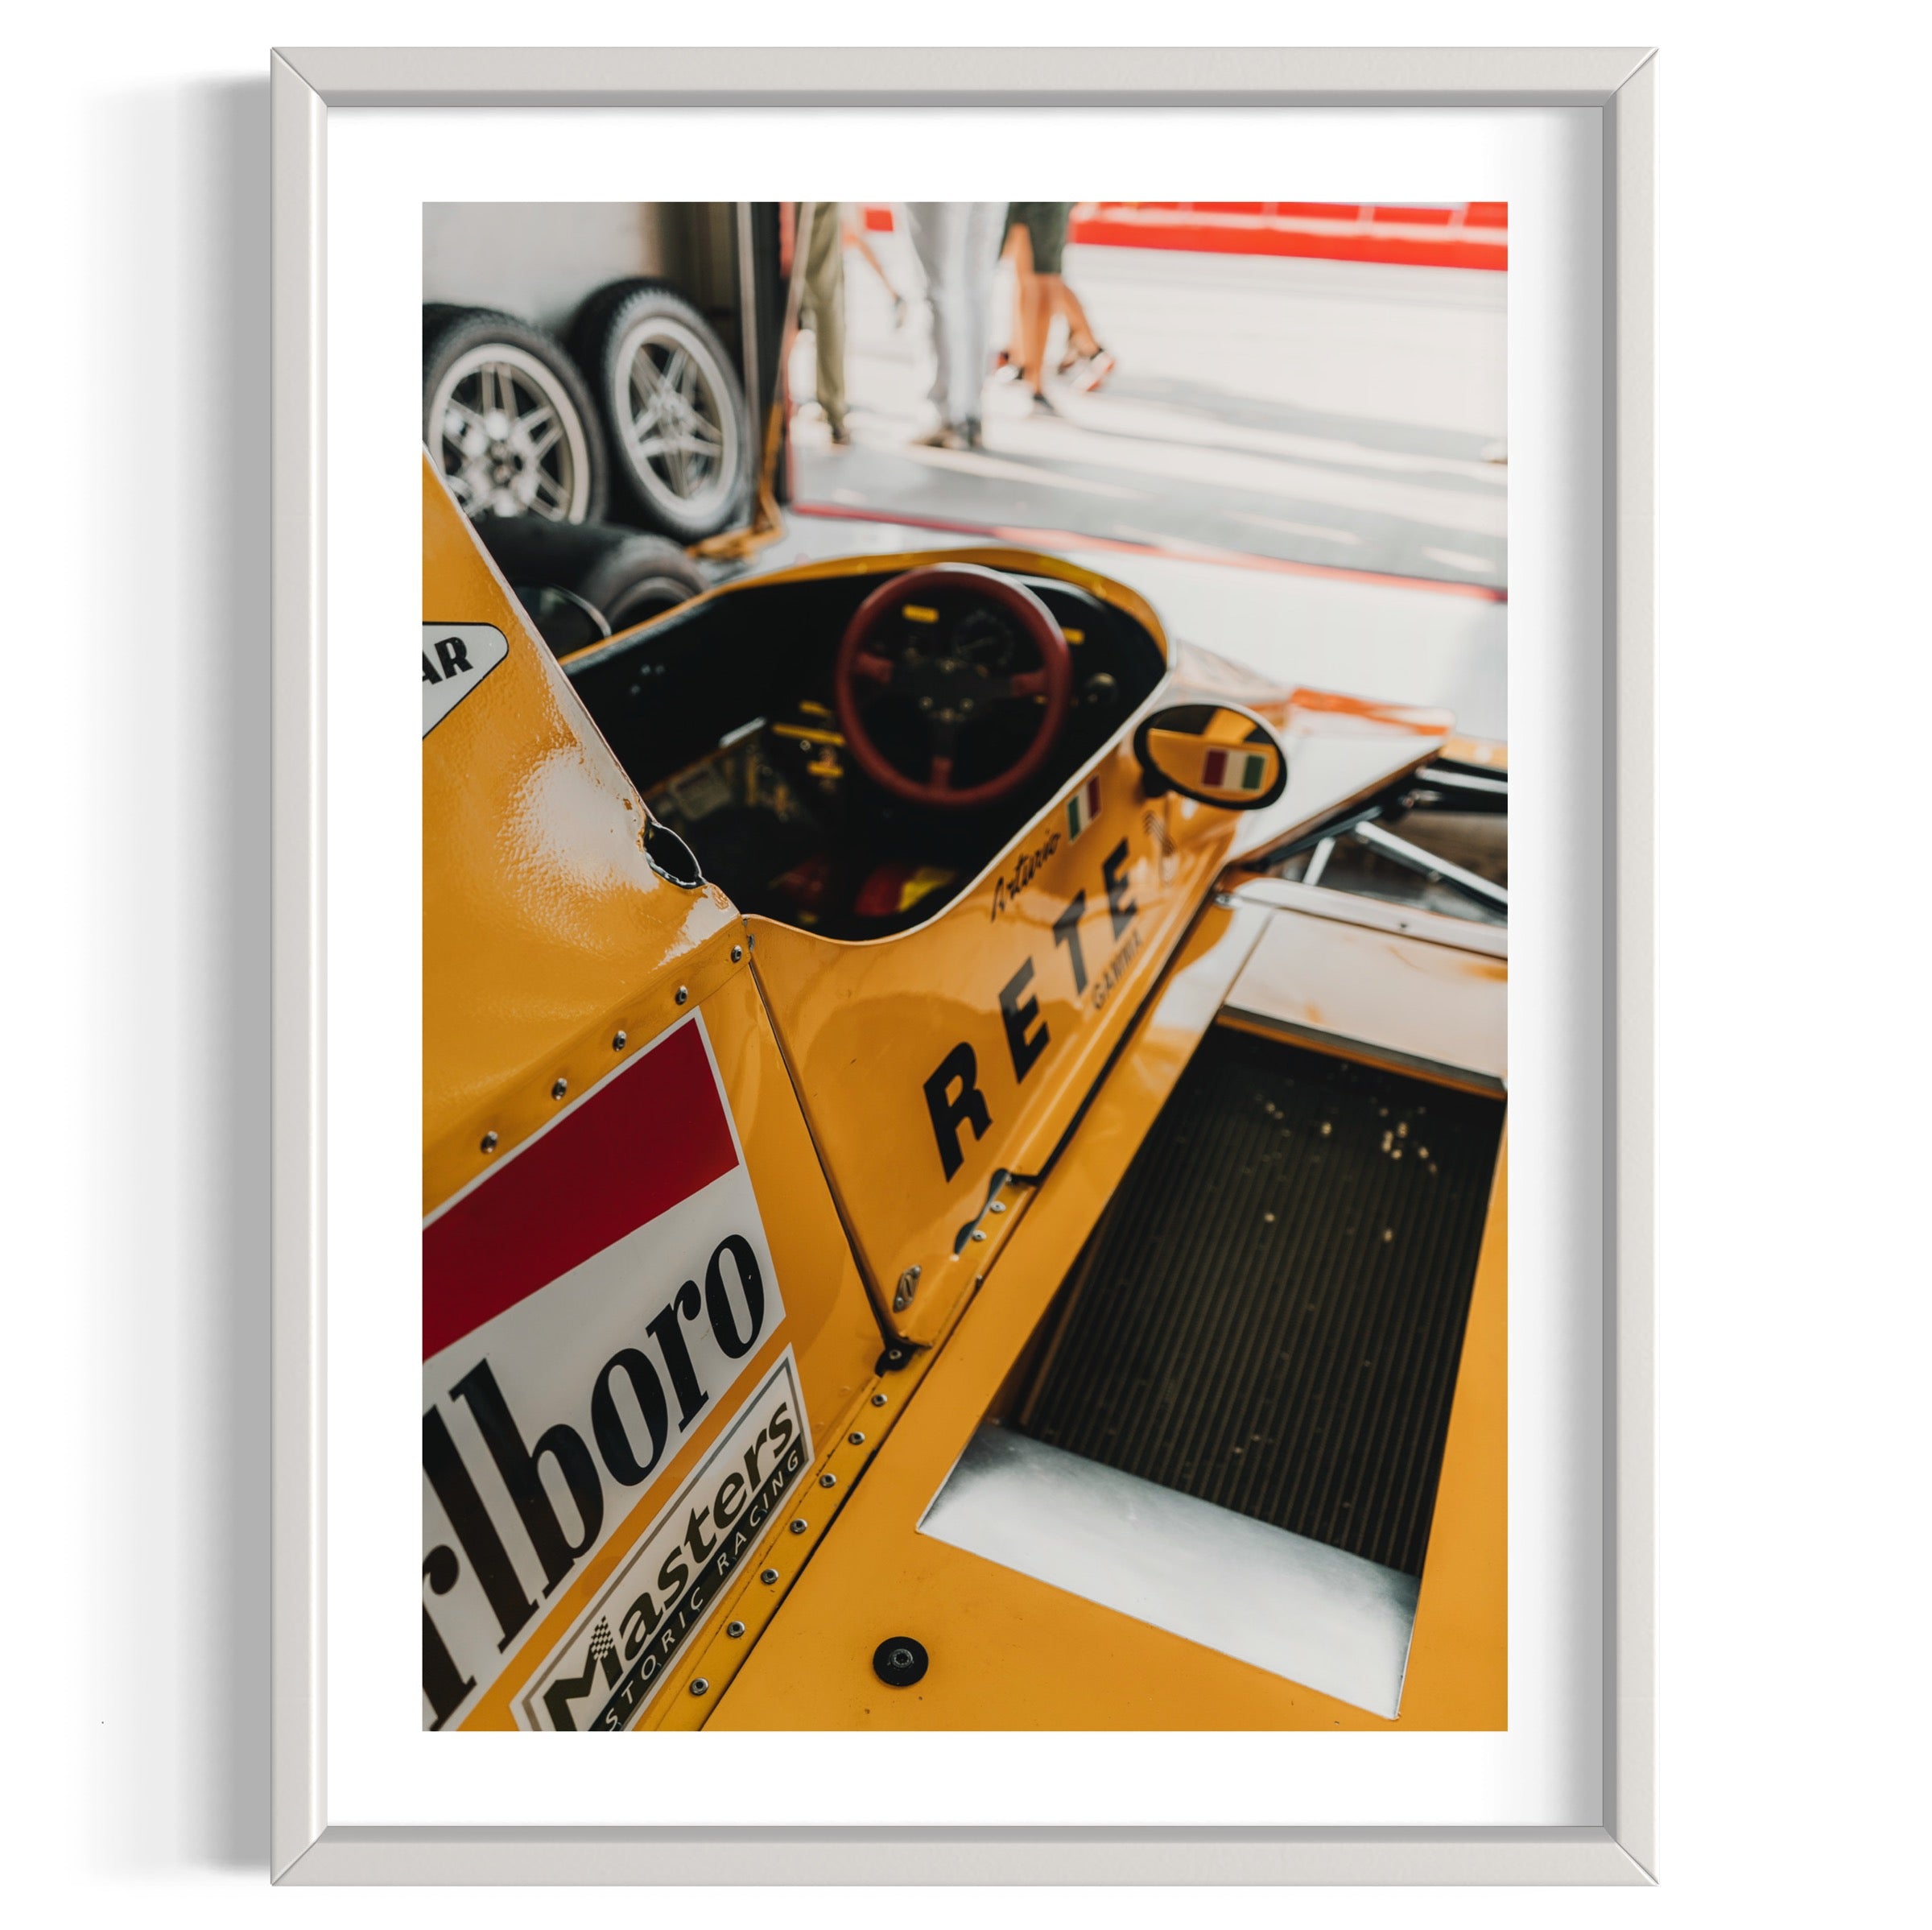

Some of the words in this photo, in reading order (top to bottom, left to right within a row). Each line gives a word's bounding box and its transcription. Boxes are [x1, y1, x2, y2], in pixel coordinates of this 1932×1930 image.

[923, 837, 1137, 1183] RETE
[543, 1402, 793, 1731] Masters
[605, 1587, 703, 1731] STORIC
[716, 1456, 798, 1575] RACING
